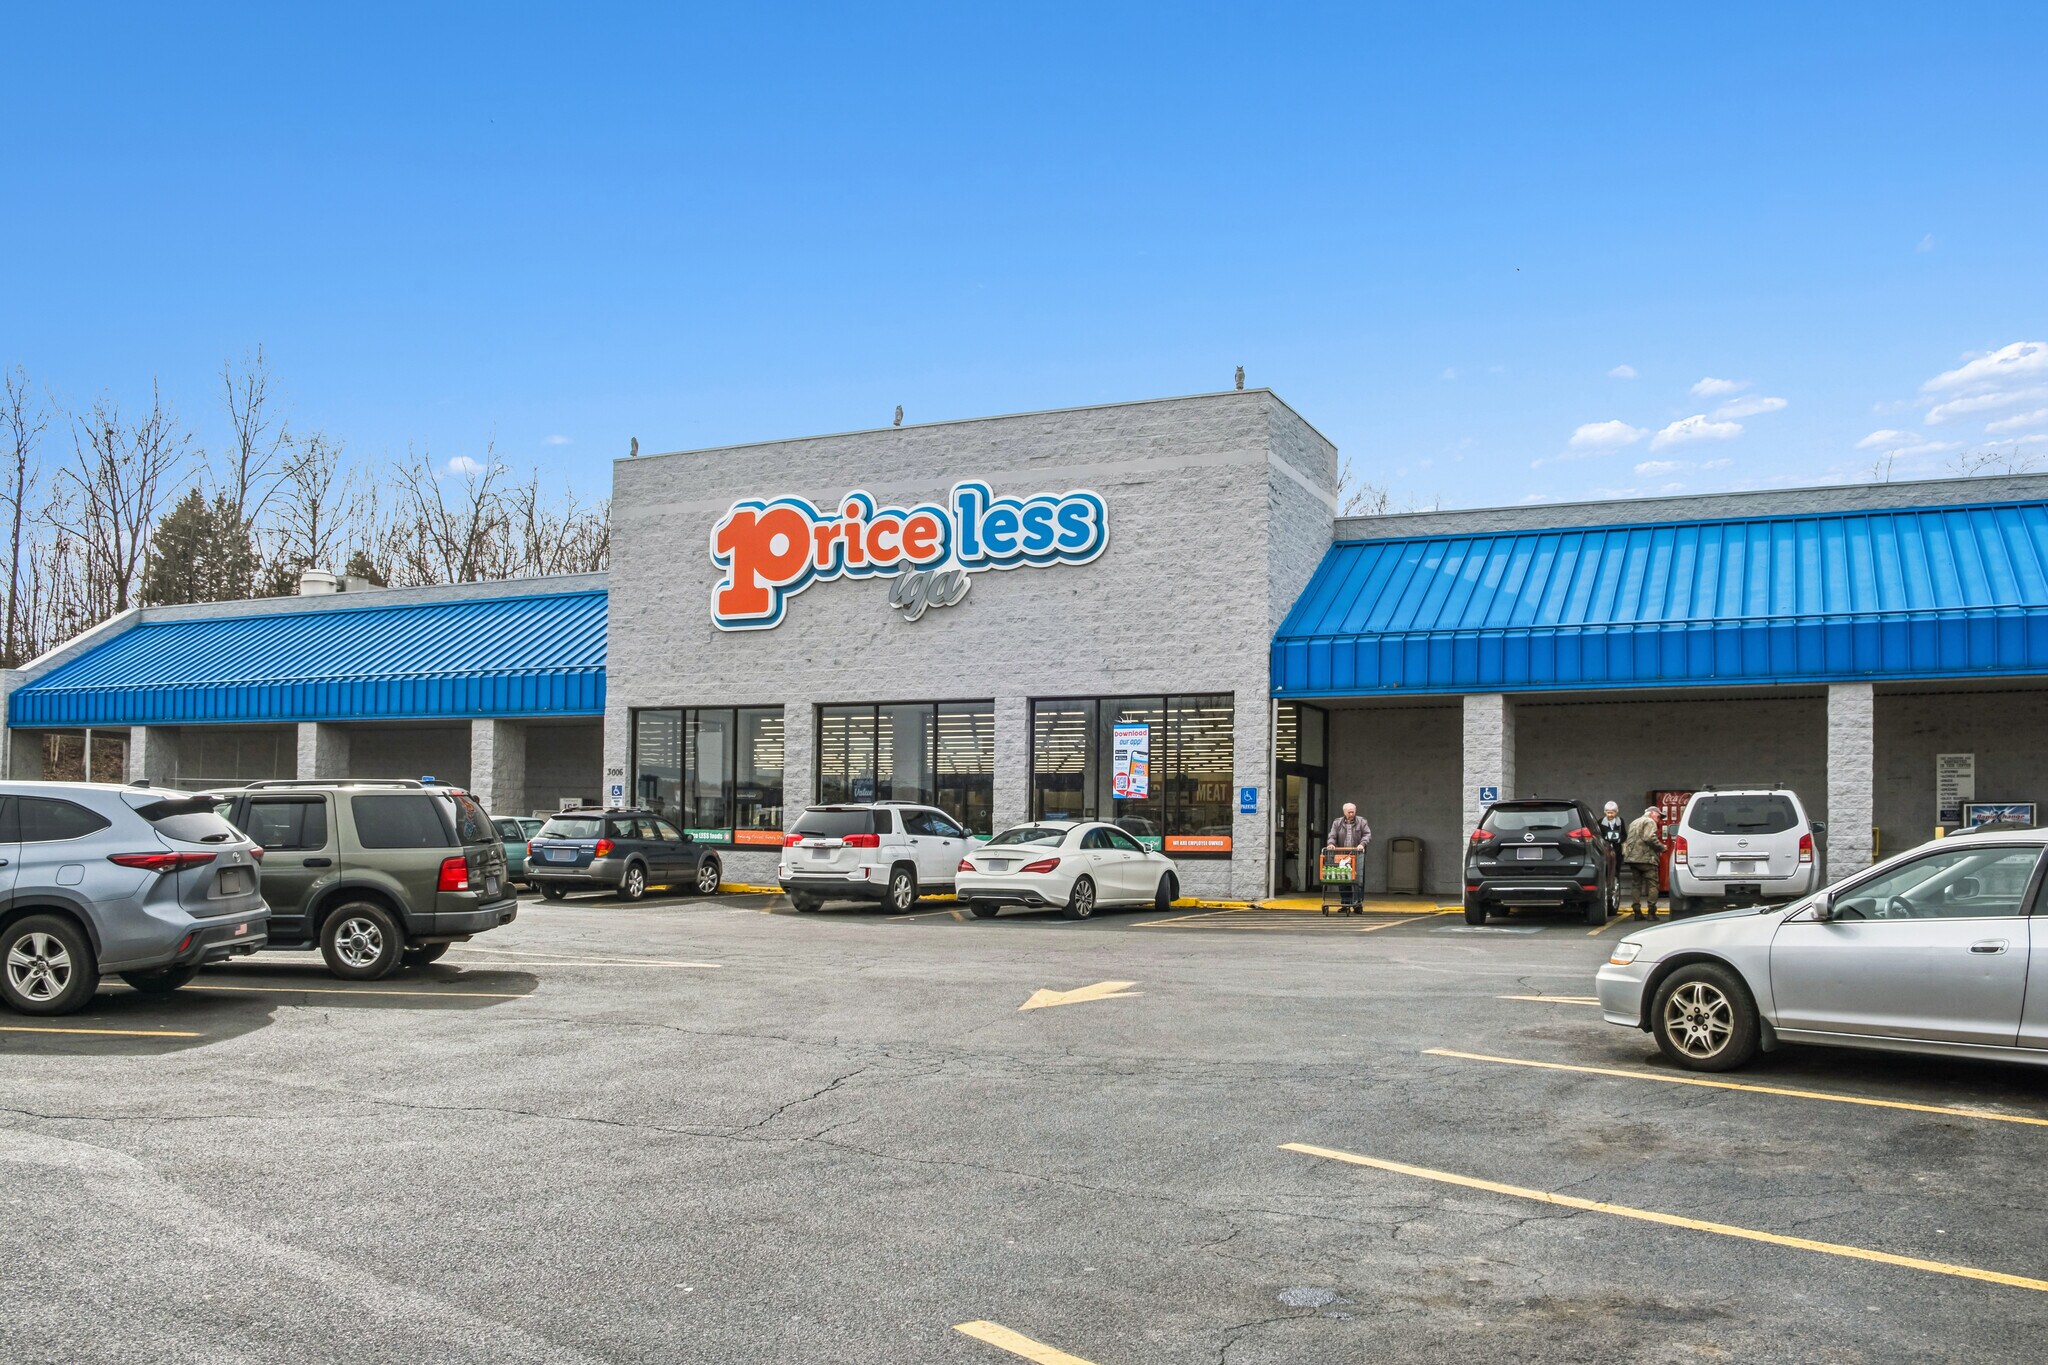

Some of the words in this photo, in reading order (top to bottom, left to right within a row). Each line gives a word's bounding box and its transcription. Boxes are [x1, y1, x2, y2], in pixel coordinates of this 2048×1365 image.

[889, 561, 969, 621] iga
[607, 768, 624, 777] 3006
[1196, 783, 1228, 802] MEAT
